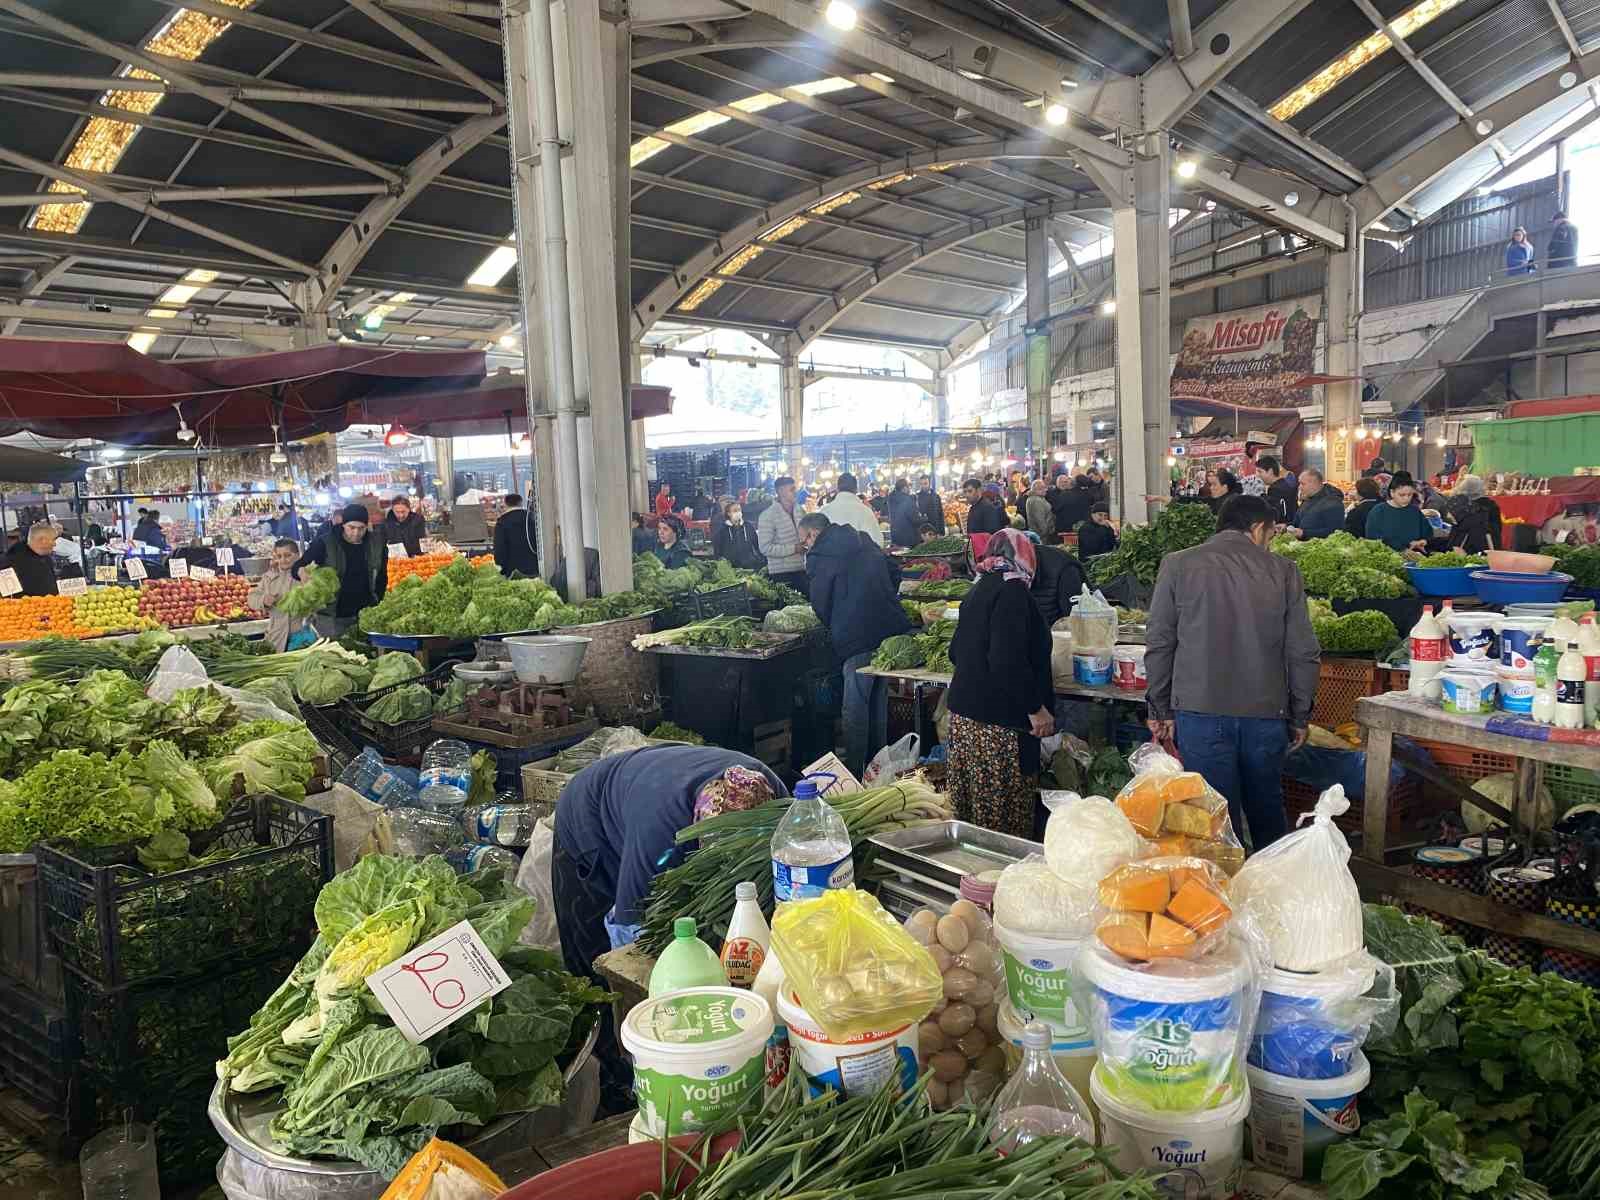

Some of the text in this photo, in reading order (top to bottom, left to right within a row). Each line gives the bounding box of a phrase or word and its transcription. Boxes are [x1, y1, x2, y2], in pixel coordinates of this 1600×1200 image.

[1211, 310, 1287, 348] Misafir
[1016, 966, 1068, 993] Yoğur
[703, 999, 731, 1033] Yoğurt
[1143, 1047, 1195, 1071] oğurt
[681, 1073, 748, 1104] Yoğurt
[1152, 1145, 1207, 1168] Yoğurt
